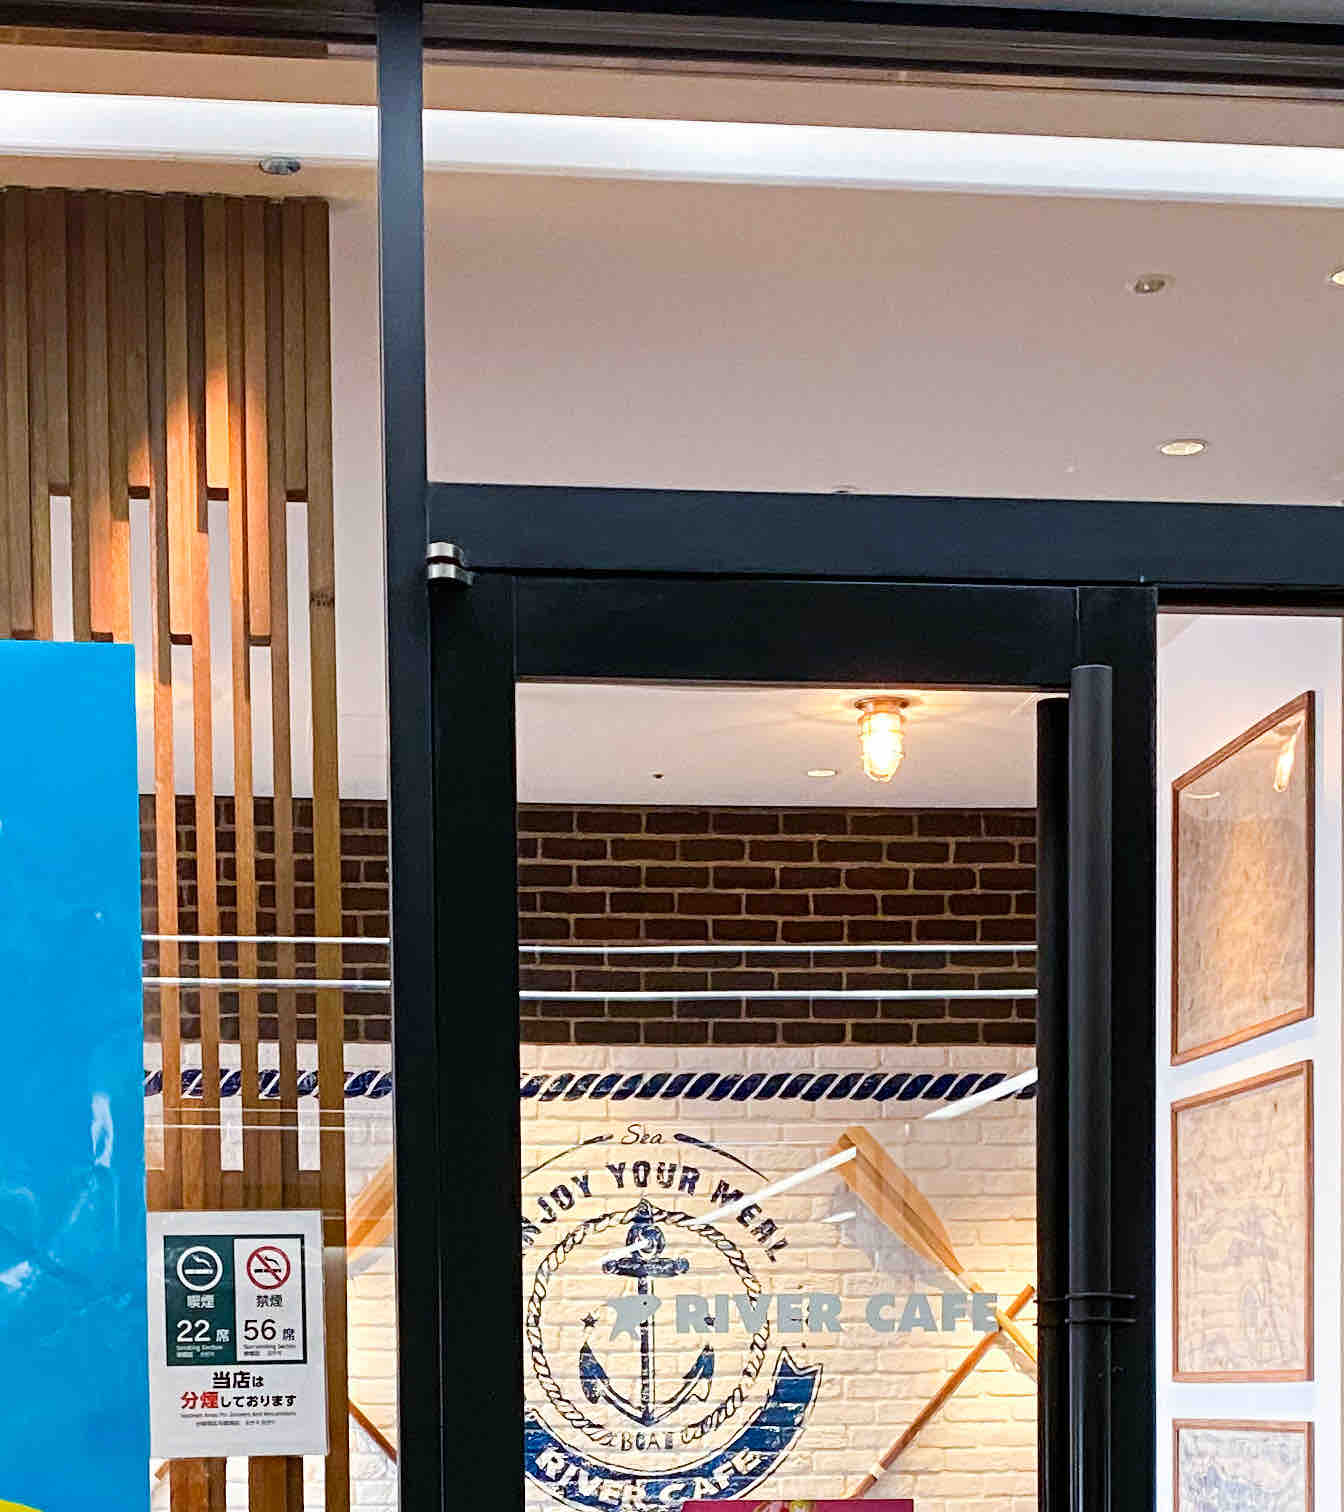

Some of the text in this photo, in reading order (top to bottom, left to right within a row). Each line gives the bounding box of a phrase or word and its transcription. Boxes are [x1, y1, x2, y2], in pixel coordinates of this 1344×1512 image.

[607, 1160, 701, 1197] YOUR
[675, 1291, 998, 1333] RIVER CAFE
[176, 1318, 212, 1343] 22
[243, 1319, 277, 1341] 56
[212, 1371, 265, 1390] 当店は
[180, 1391, 297, 1410] 分煙しております
